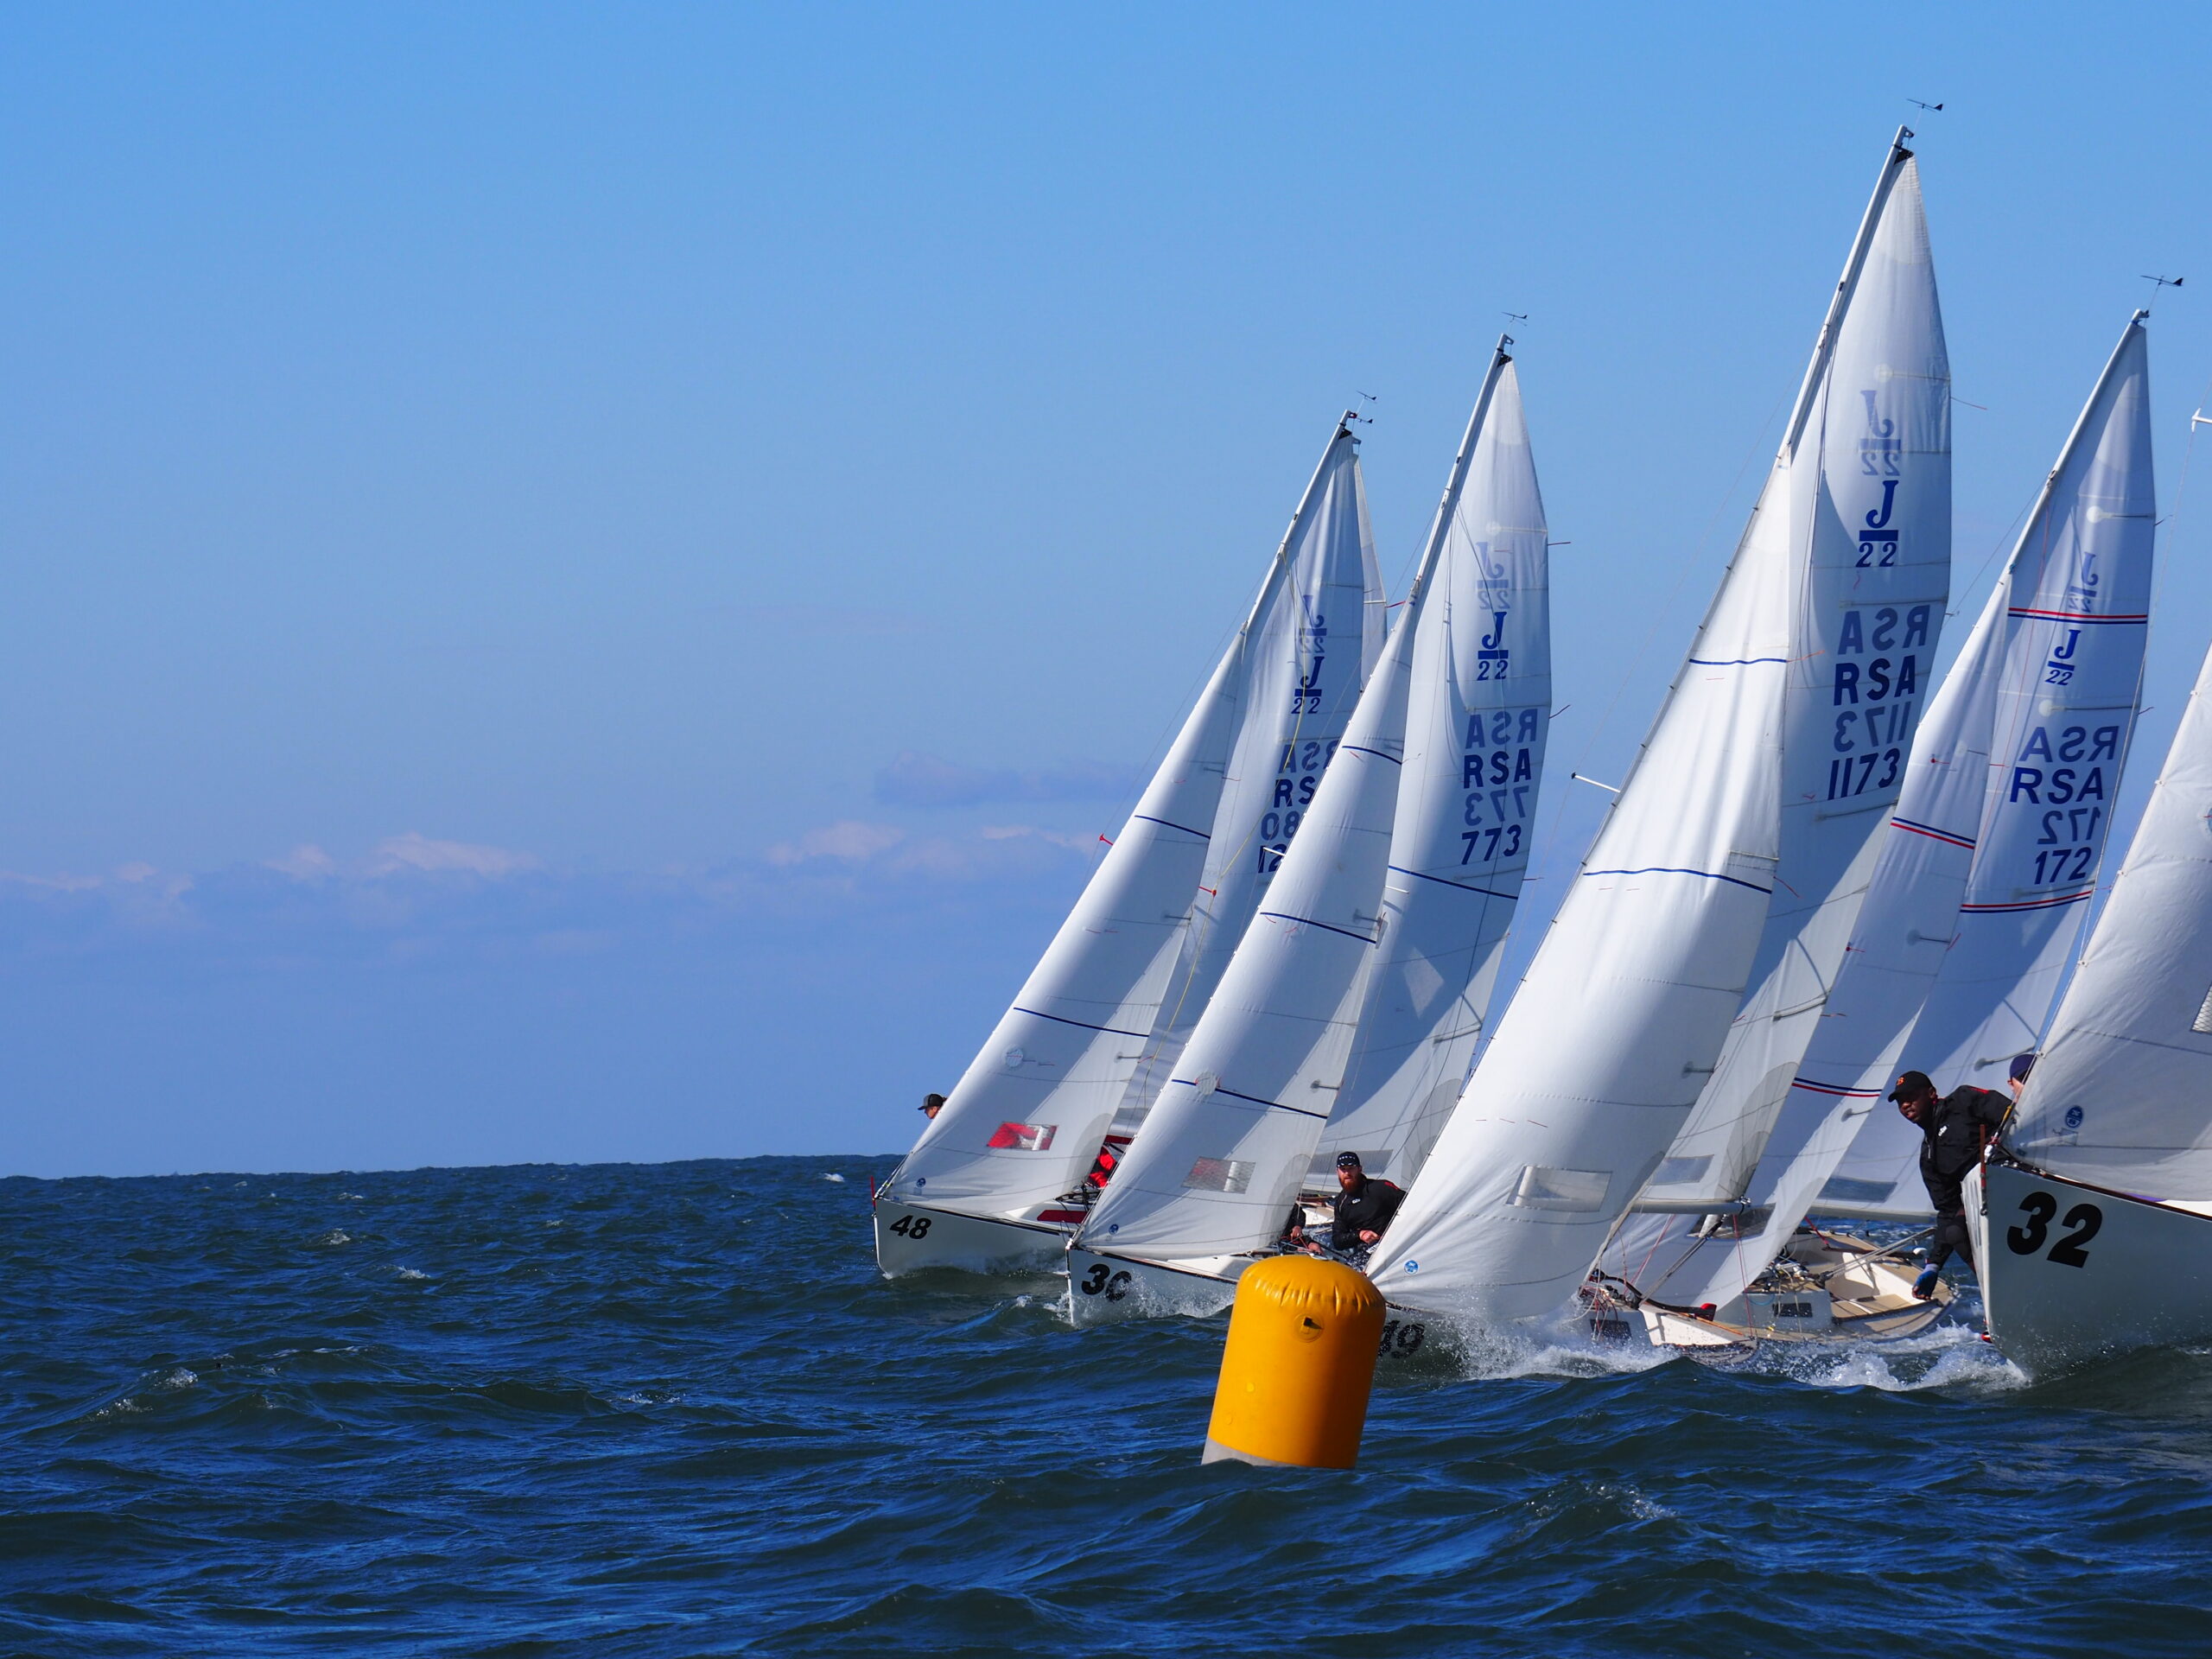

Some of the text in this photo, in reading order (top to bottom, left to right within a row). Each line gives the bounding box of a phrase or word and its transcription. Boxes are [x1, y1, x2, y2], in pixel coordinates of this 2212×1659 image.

[1866, 480, 1899, 529] J
[1855, 542, 1897, 568] 22
[1482, 612, 1507, 650] J
[2054, 629, 2081, 659] J
[1300, 657, 1325, 689] J
[1477, 660, 1509, 681] 22
[1833, 654, 1916, 706] RSA
[2044, 670, 2073, 686] 22
[1291, 697, 1321, 714] 22
[1464, 748, 1531, 789] RSA
[1827, 747, 1900, 800] 1173
[2010, 766, 2103, 804] RSA
[1461, 824, 1522, 865] 773
[2034, 847, 2091, 885] 172
[889, 1215, 931, 1239] 48
[2007, 1192, 2102, 1268] 32
